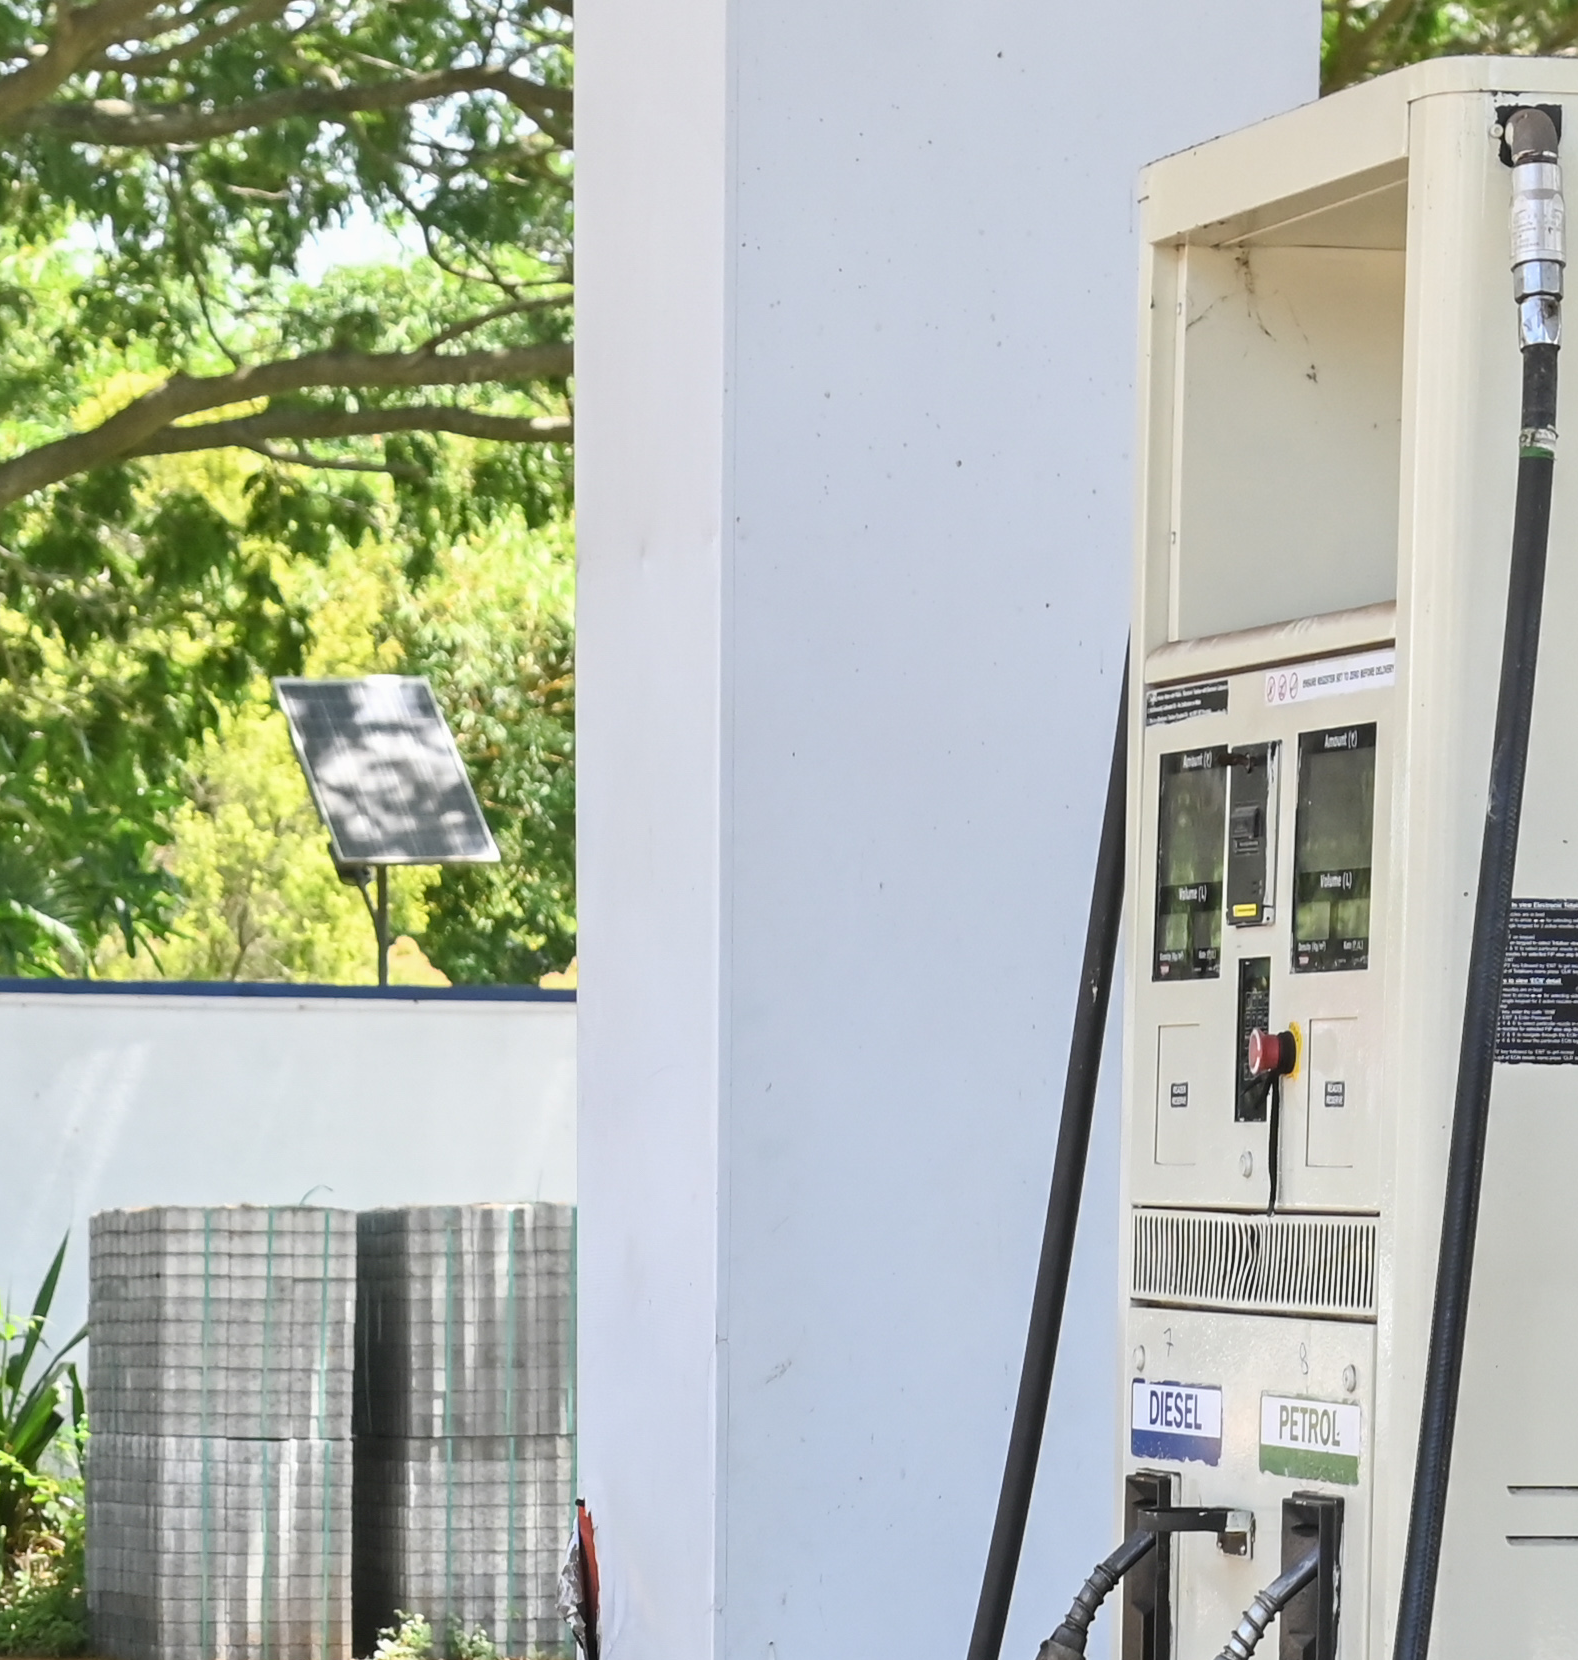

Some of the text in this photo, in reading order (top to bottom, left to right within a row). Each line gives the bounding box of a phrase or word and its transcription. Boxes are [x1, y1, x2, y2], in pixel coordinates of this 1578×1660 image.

[1324, 732, 1346, 747] Amount
[1182, 752, 1203, 768] Amount
[1320, 872, 1341, 888] Volume
[1179, 886, 1196, 901] Volume
[1149, 1390, 1202, 1430] DIESEL
[1279, 1404, 1340, 1446] PETROL
